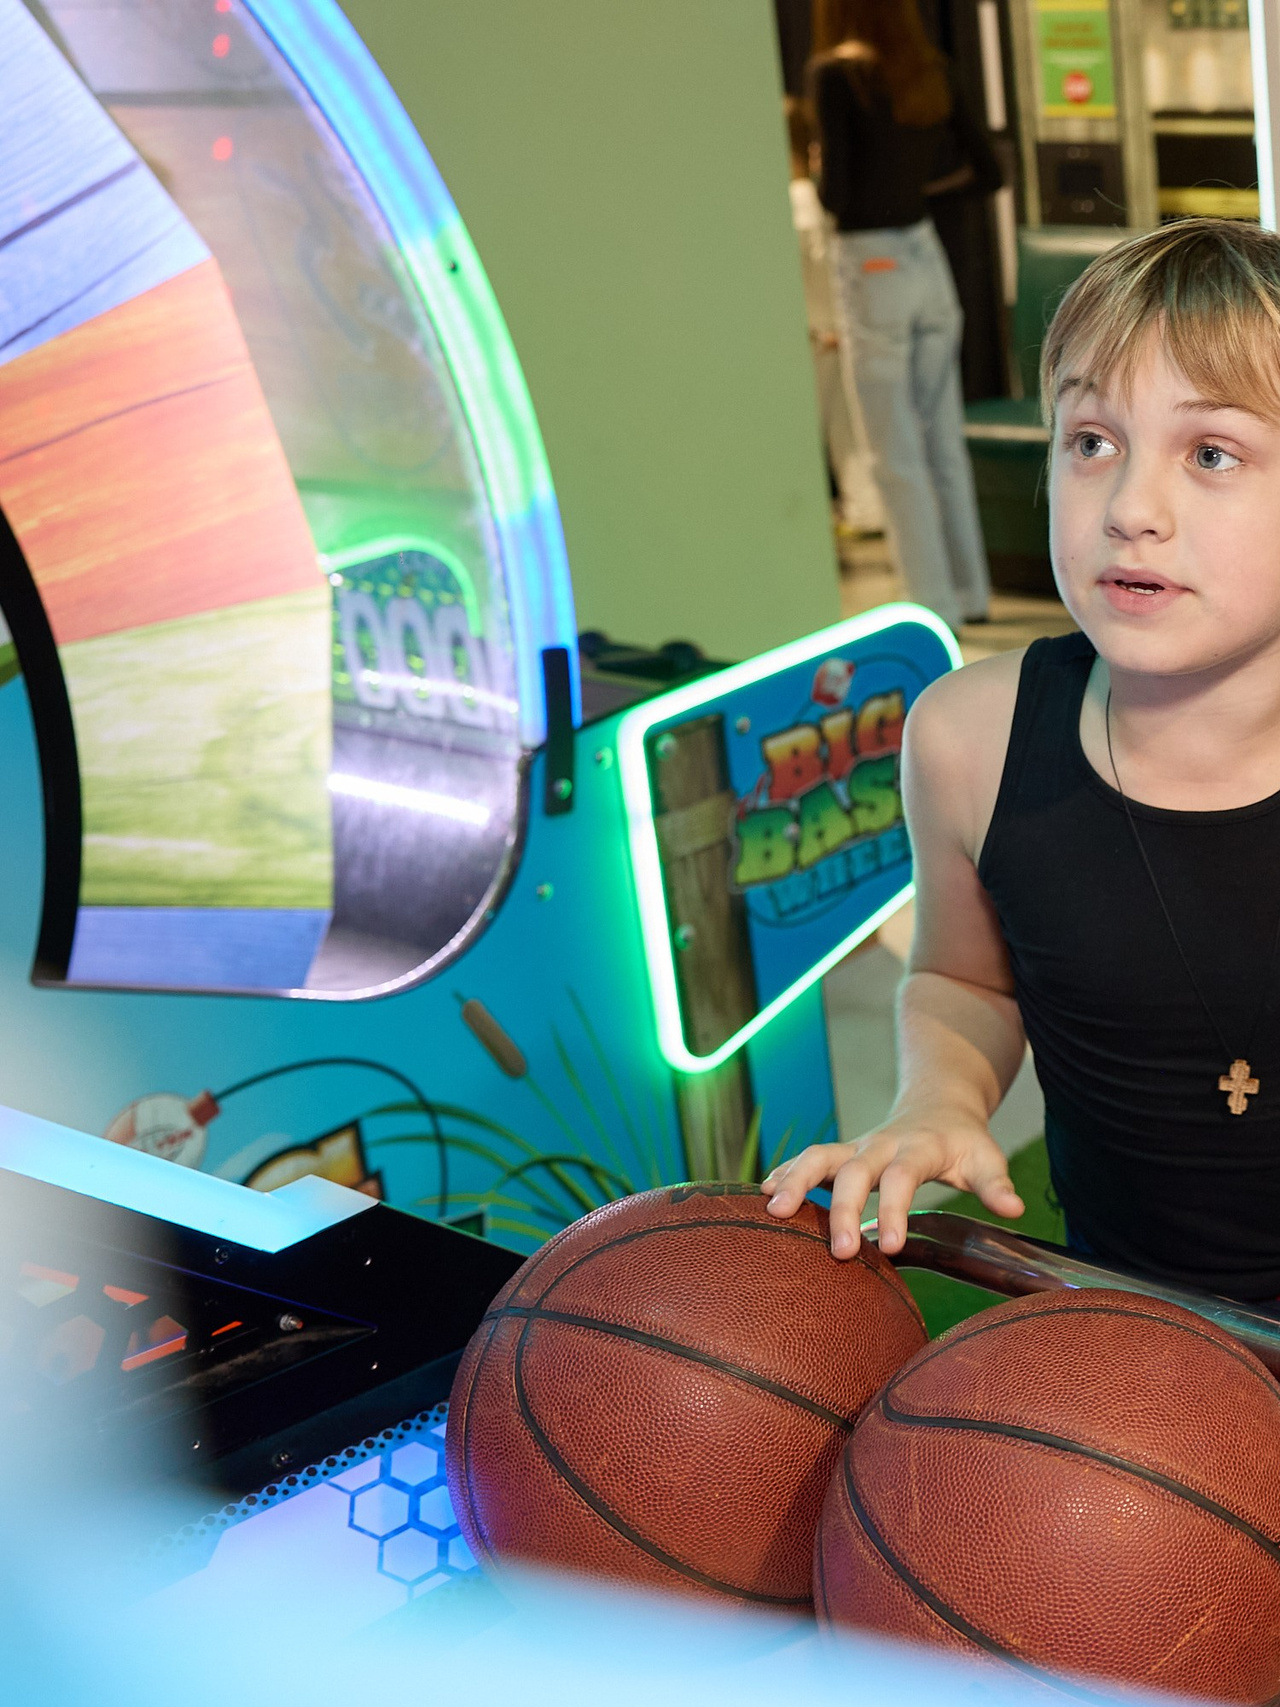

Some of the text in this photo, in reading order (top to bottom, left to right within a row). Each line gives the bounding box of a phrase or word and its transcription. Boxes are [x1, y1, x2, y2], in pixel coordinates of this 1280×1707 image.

[762, 688, 905, 803] BIG
[735, 753, 907, 886] BAS
[747, 822, 914, 918] WHEE
